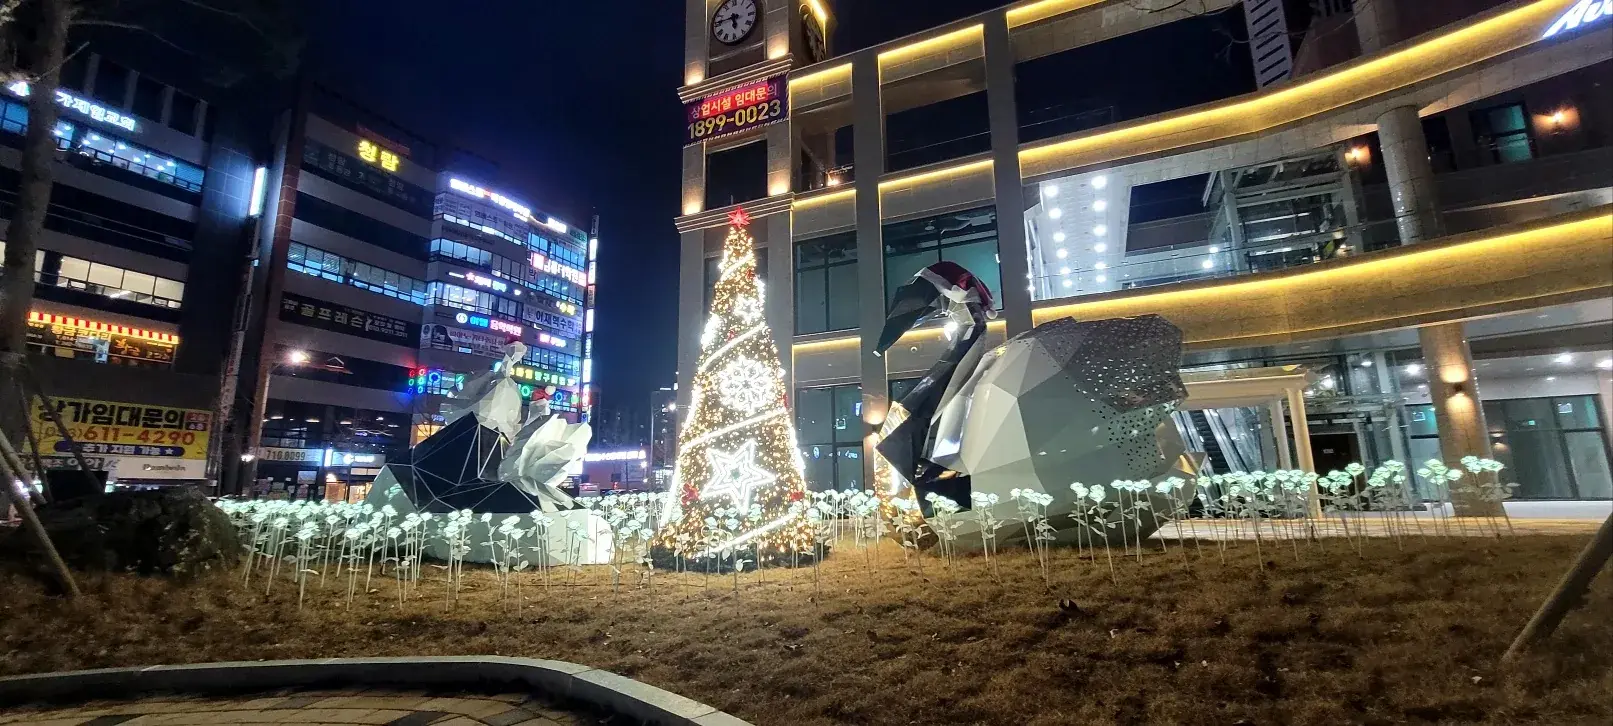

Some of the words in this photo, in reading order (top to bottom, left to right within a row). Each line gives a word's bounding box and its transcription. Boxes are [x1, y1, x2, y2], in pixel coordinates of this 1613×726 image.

[690, 96, 732, 119] 상업시설
[735, 83, 778, 108] 임대문의
[688, 99, 781, 140] 1899-0023
[300, 303, 364, 328] 골프레슨
[38, 400, 185, 430] 상가임대문의
